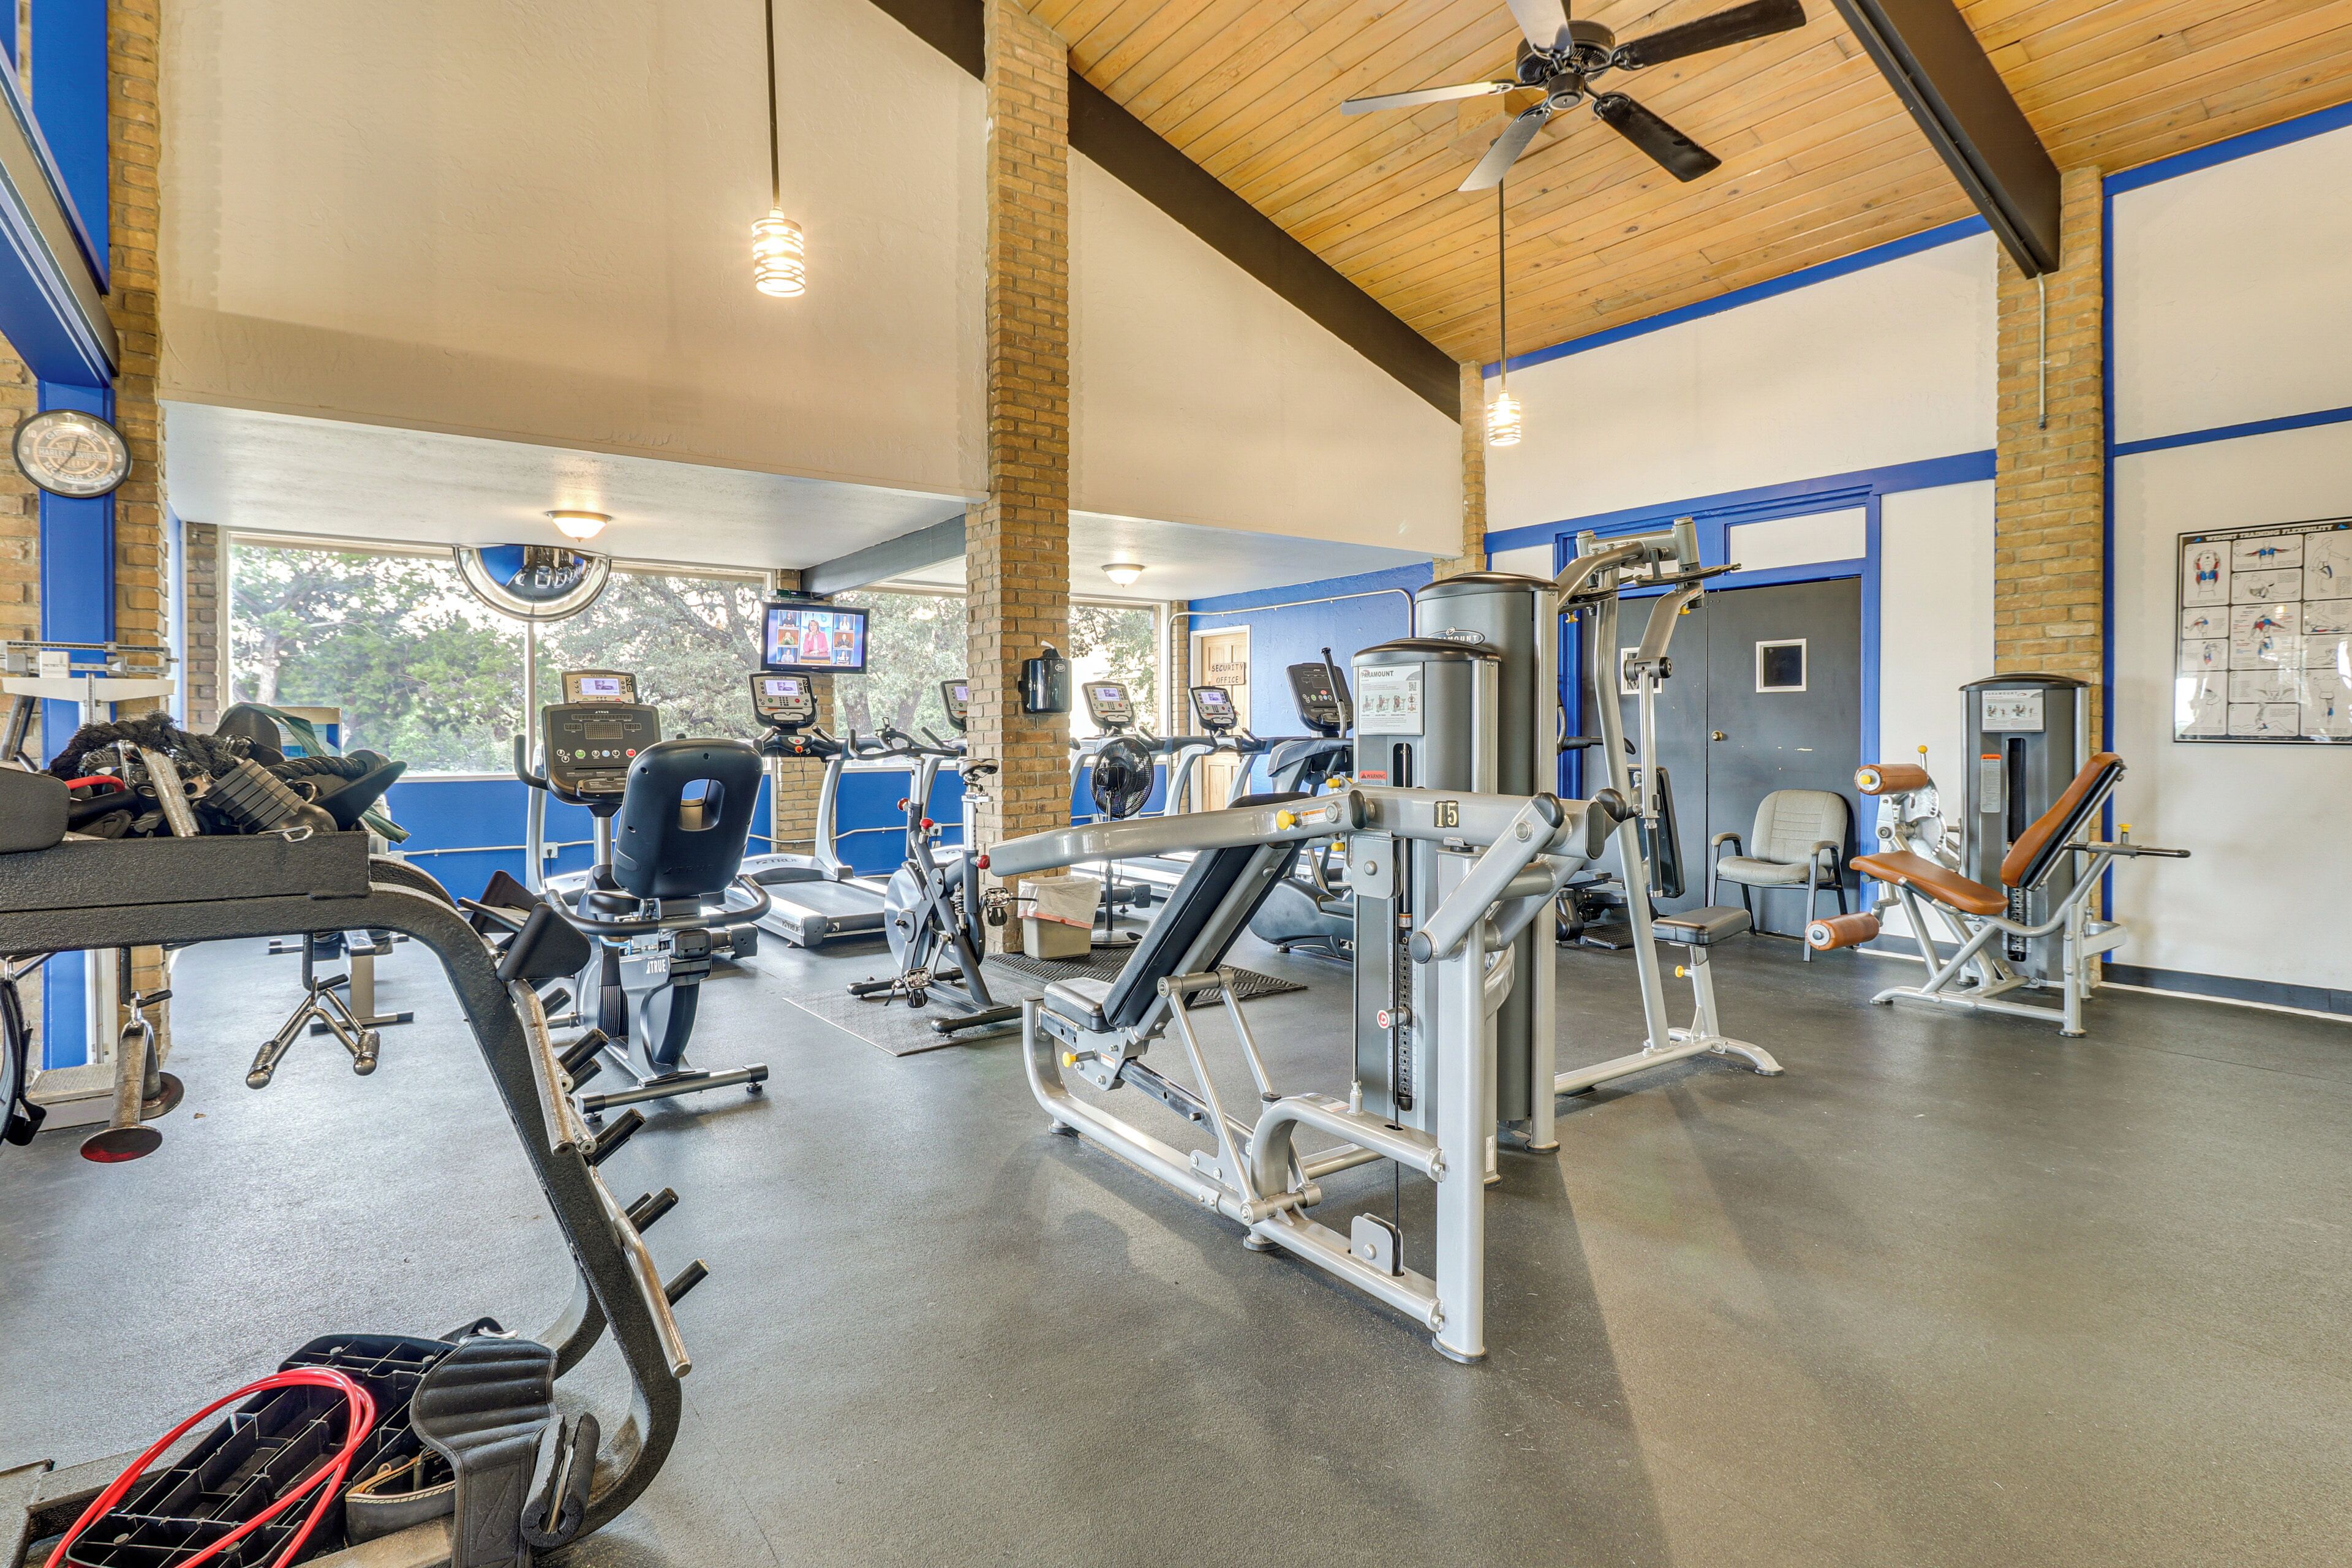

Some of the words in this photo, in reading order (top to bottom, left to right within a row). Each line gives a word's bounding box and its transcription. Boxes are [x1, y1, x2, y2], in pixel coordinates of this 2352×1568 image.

[108, 437, 115, 445] 2
[115, 454, 122, 462] 3
[2239, 529, 2280, 539] TRAINING
[2281, 525, 2334, 535] FLEXIBILITY
[1212, 663, 1243, 672] SECURITY
[1437, 801, 1458, 827] 15
[650, 959, 666, 973] TRUE
